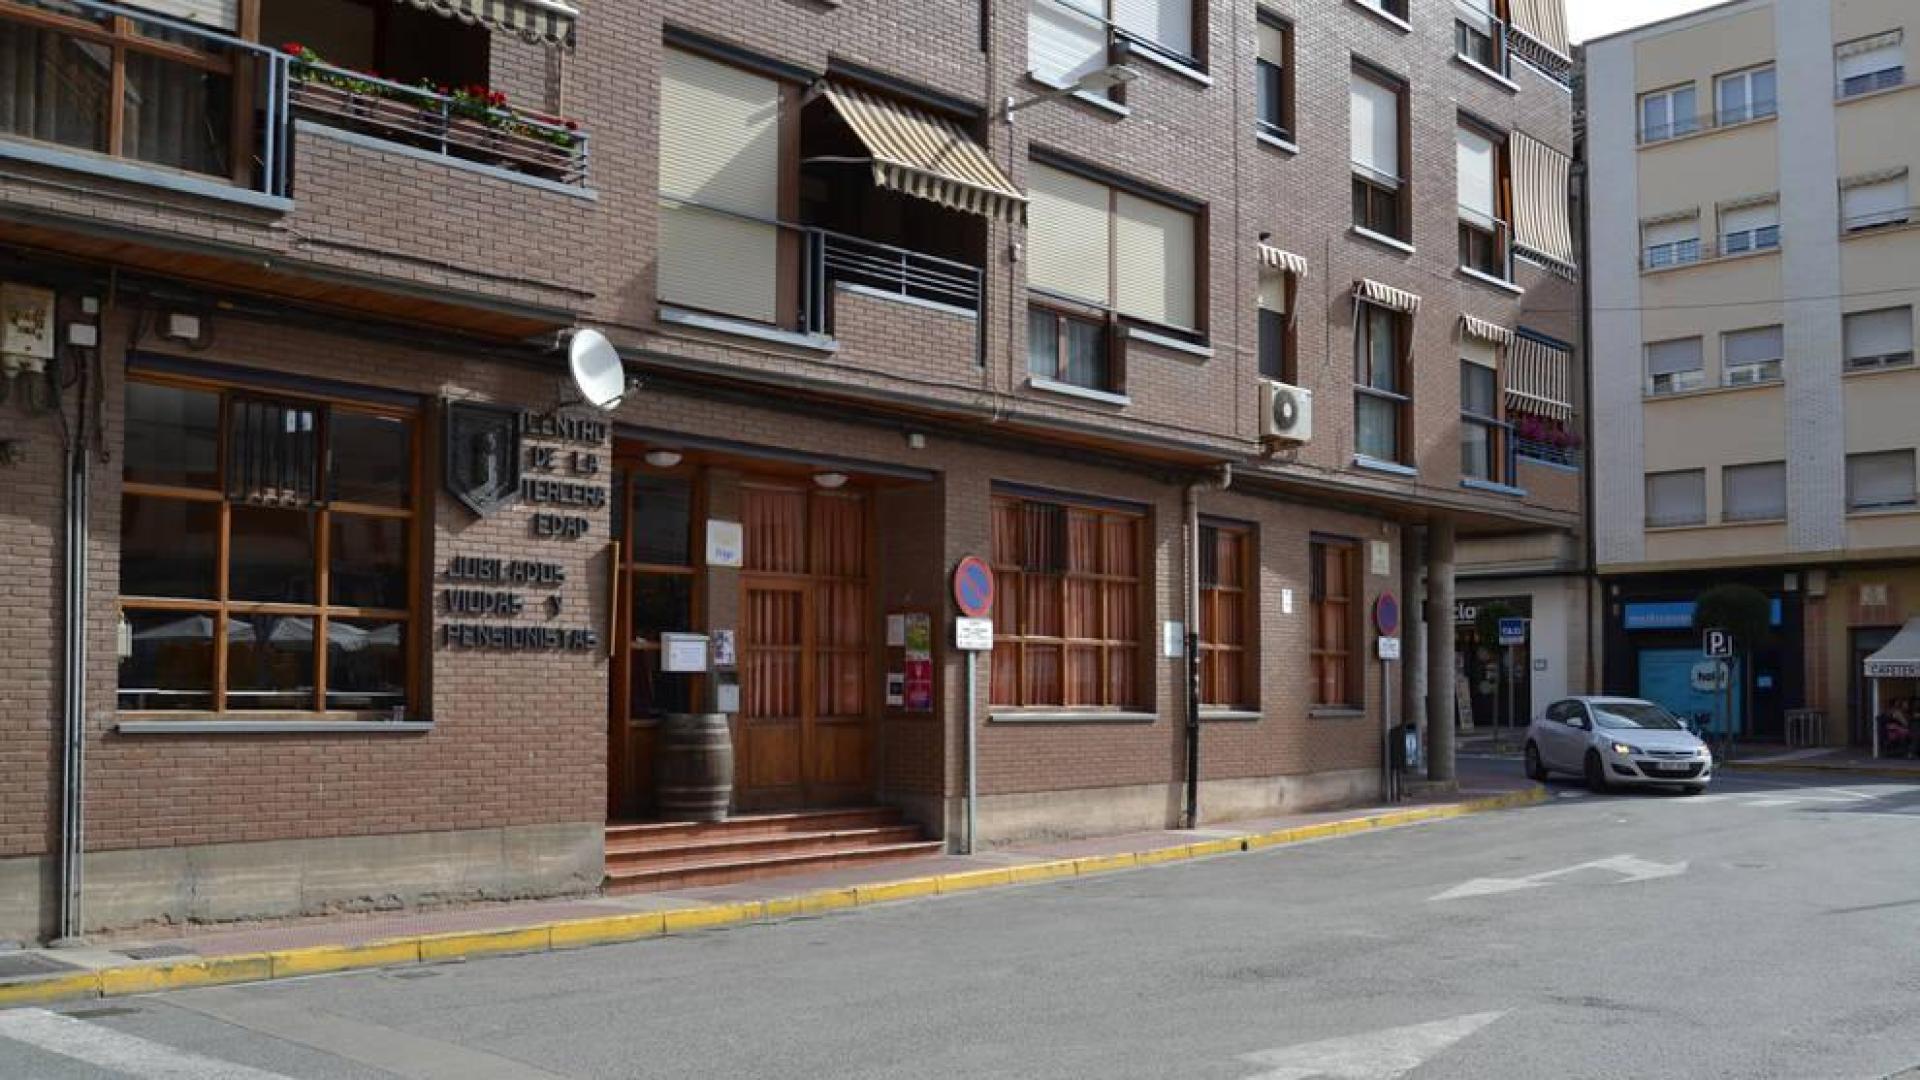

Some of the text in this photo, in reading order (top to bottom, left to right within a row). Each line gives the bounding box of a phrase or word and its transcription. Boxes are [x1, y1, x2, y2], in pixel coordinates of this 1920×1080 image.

[531, 446, 600, 474] DE LA
[521, 479, 605, 507] TERCERA
[533, 512, 589, 538] EDAD
[448, 556, 566, 583] JUBILADOS
[443, 589, 563, 620] VIUDAS Y
[442, 624, 598, 650] PENSIONISTAS
